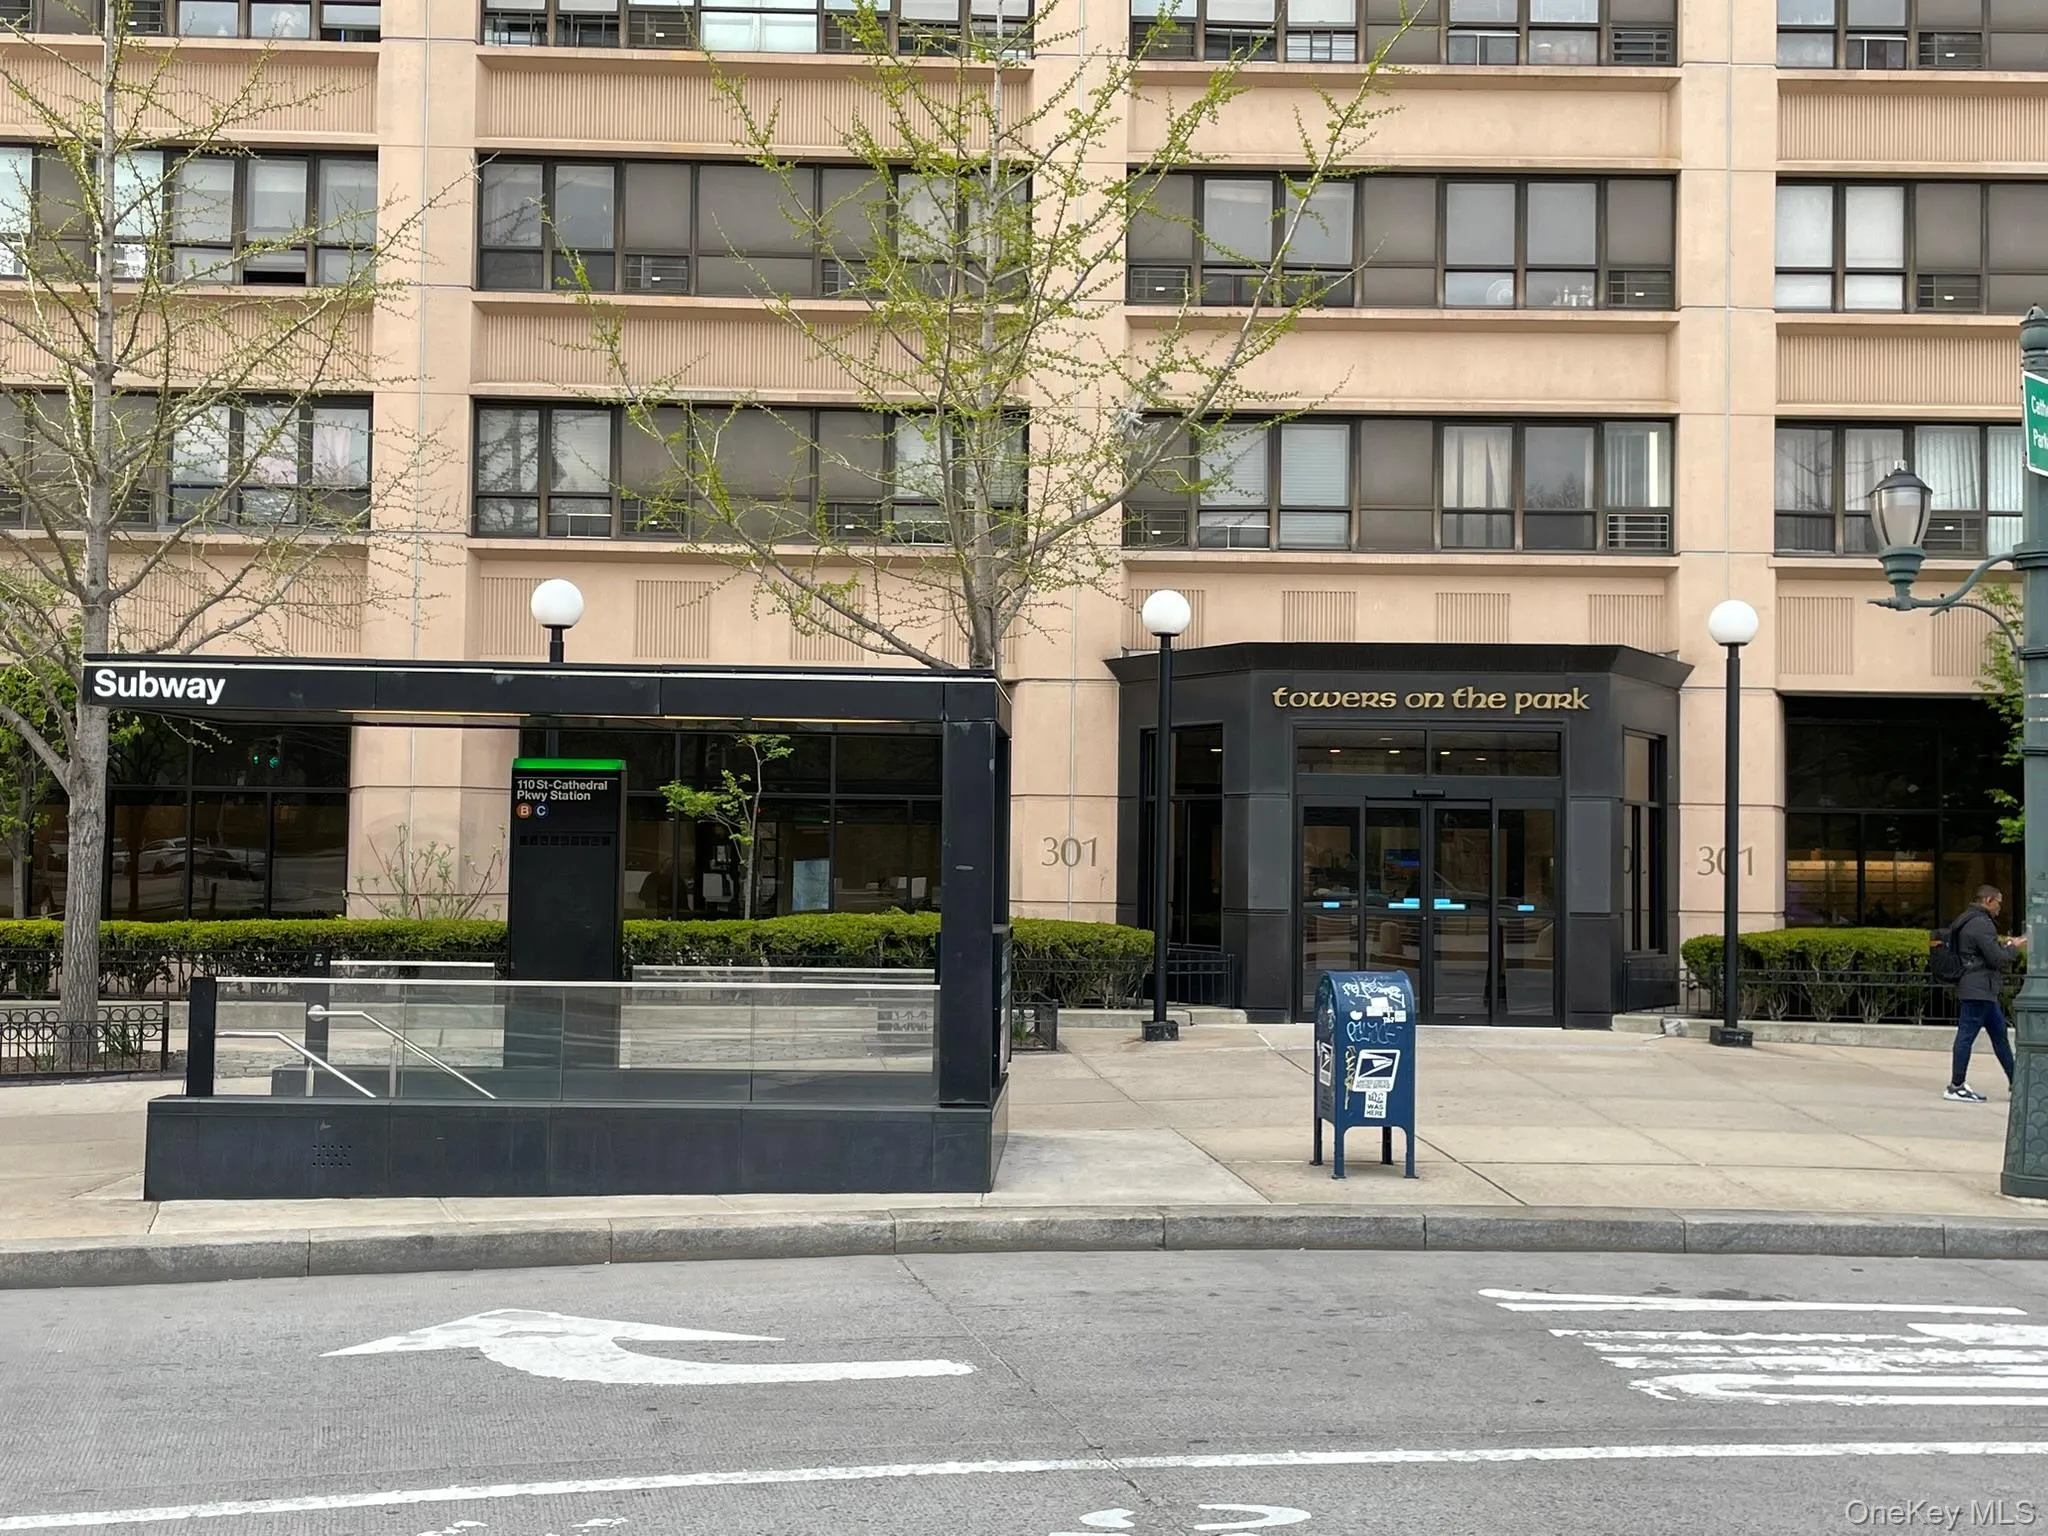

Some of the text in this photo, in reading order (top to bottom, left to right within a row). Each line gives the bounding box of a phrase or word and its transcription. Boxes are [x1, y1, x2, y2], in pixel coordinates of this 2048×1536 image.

[93, 668, 226, 705] Subway
[1272, 686, 1591, 714] towers on the park
[517, 780, 608, 790] 110 St-Cathedral
[517, 790, 591, 802] Pkwy Station
[1041, 836, 1097, 868] 301
